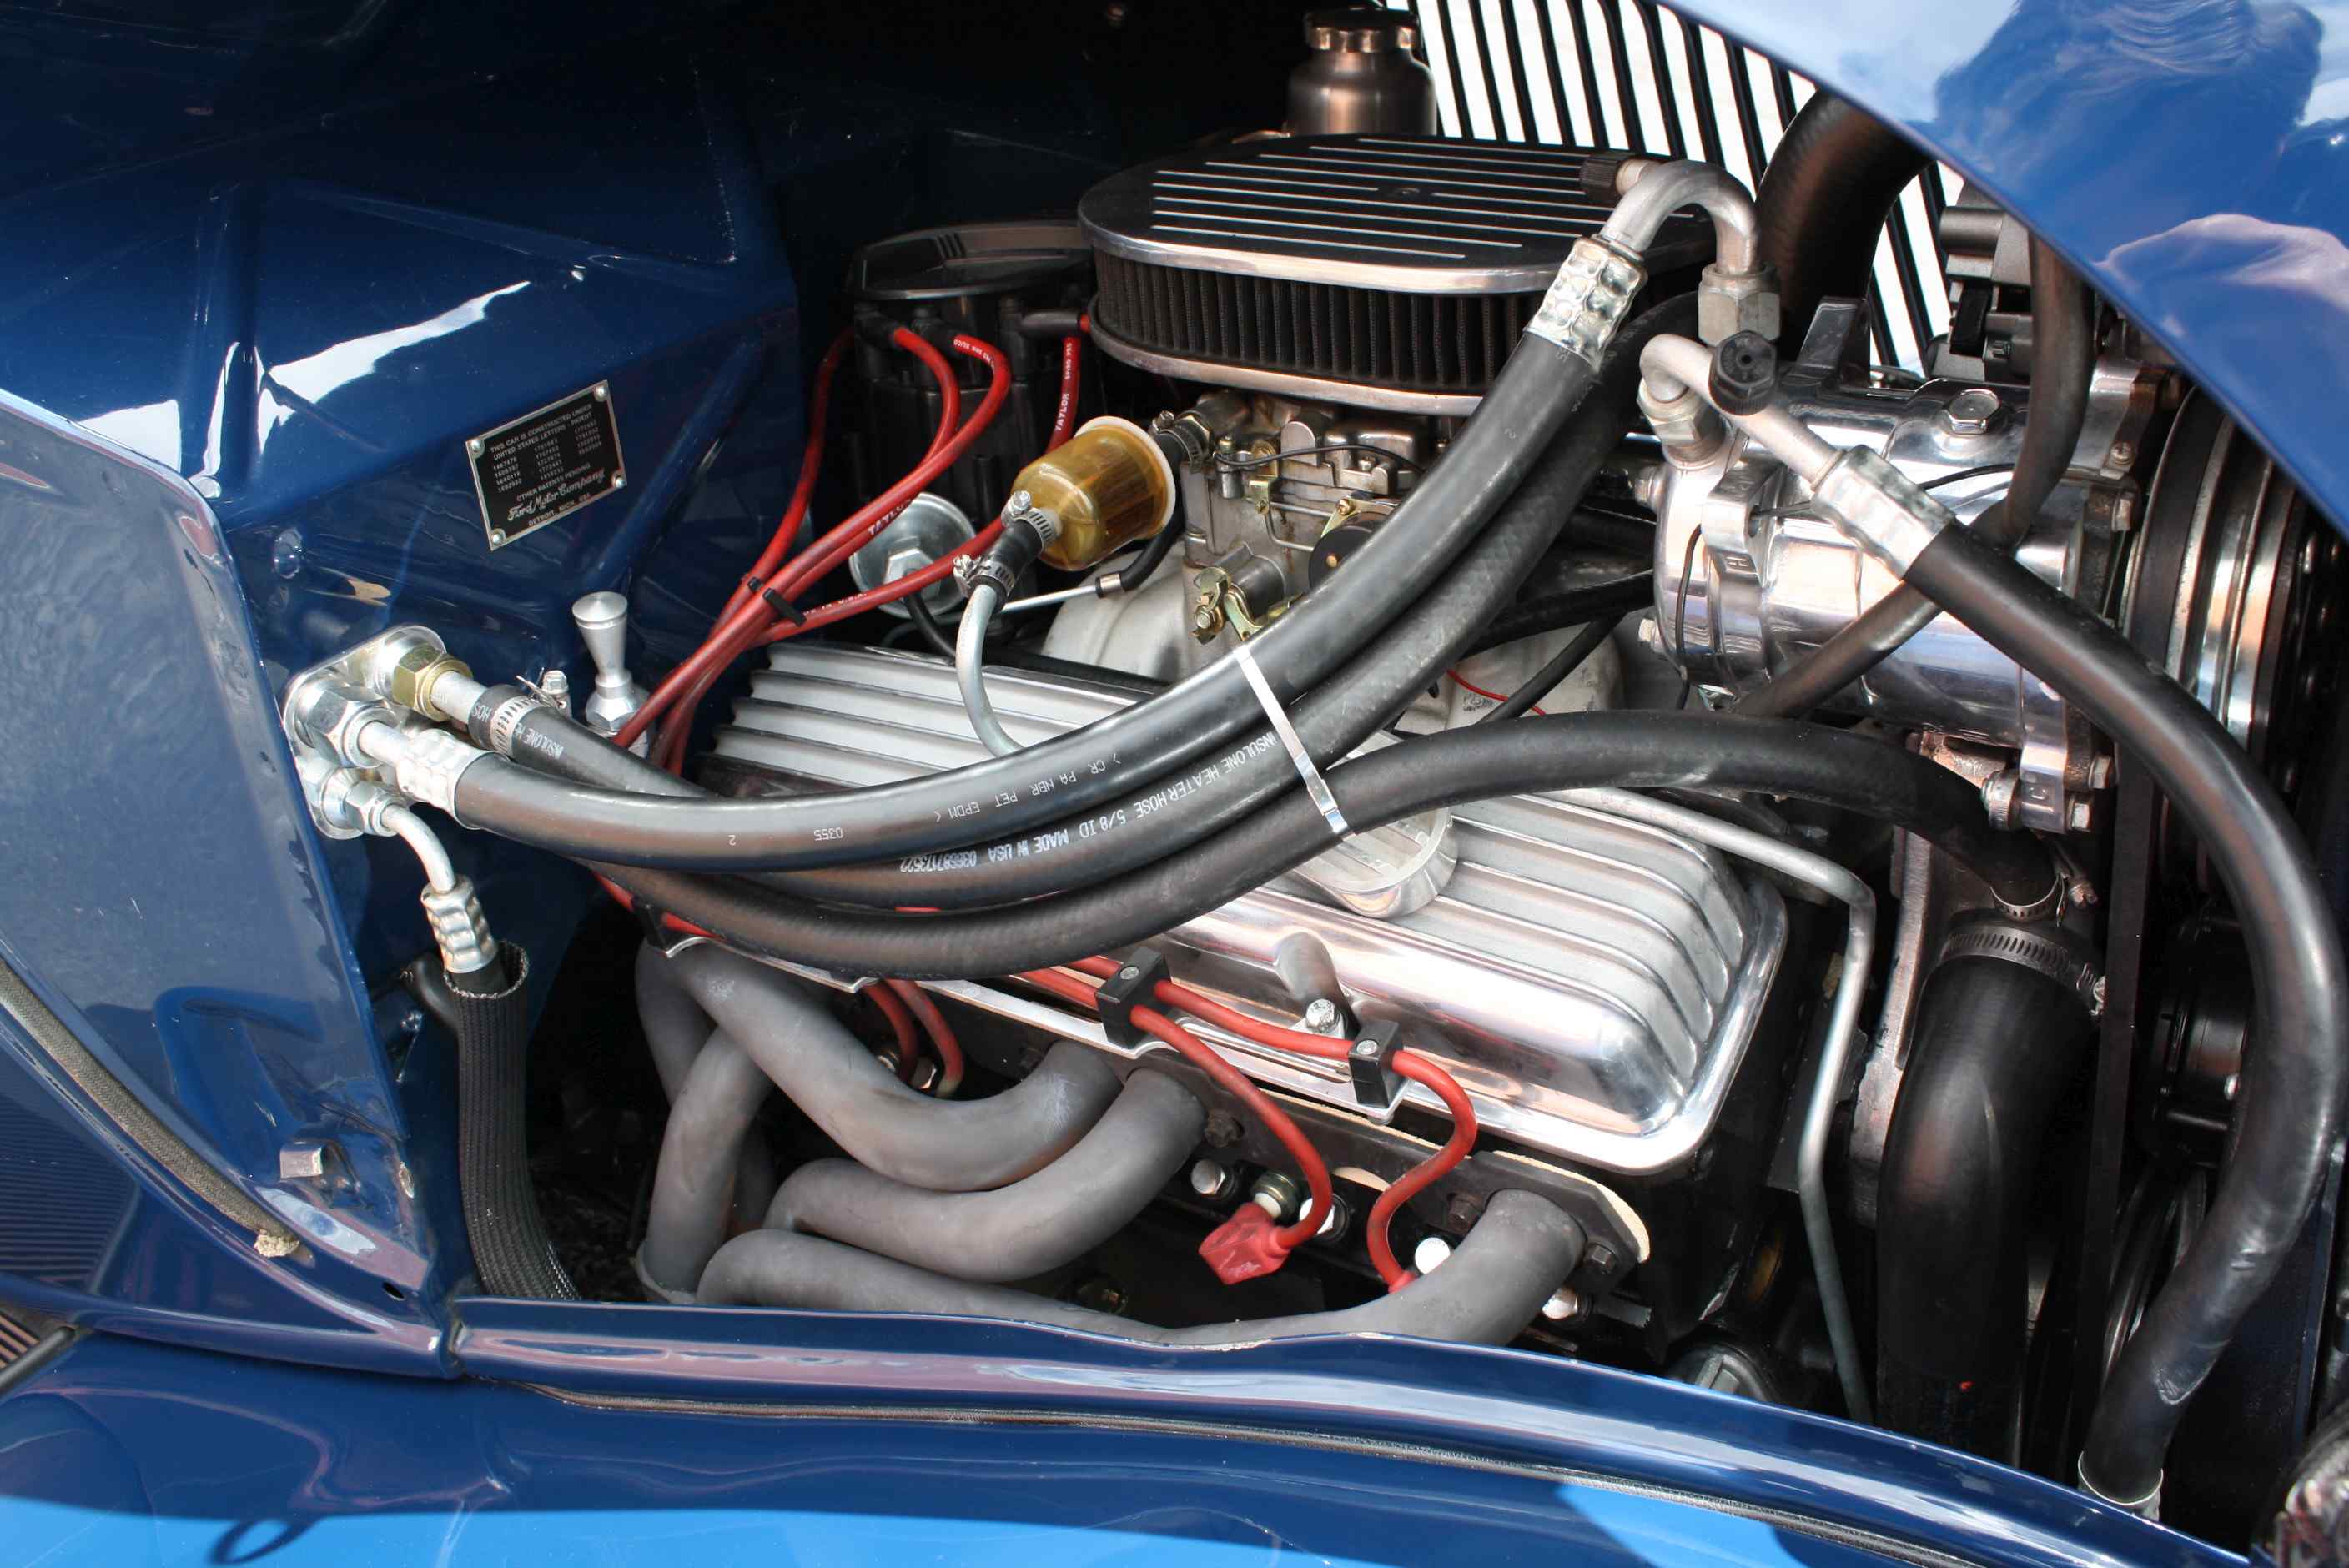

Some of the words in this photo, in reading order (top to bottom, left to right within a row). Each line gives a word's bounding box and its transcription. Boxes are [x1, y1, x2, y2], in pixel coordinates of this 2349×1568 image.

[1054, 393, 1069, 431] TAYLOR
[506, 436, 519, 445] CAR
[494, 446, 515, 460] UNITED
[507, 501, 534, 521] Ford
[535, 490, 558, 510] Motor
[557, 468, 605, 496] Company
[1088, 760, 1106, 775] CR
[1029, 777, 1055, 796] NBR
[1059, 771, 1077, 785] PA
[1167, 766, 1220, 802] HEATER
[994, 790, 1018, 807] PET
[1133, 792, 1168, 819] HOSE
[1079, 819, 1097, 838] ID
[1099, 807, 1128, 832] 5/8
[813, 827, 843, 842] 0355
[1034, 828, 1069, 853] MADE
[988, 843, 1013, 863] USA
[1017, 839, 1029, 856] IN
